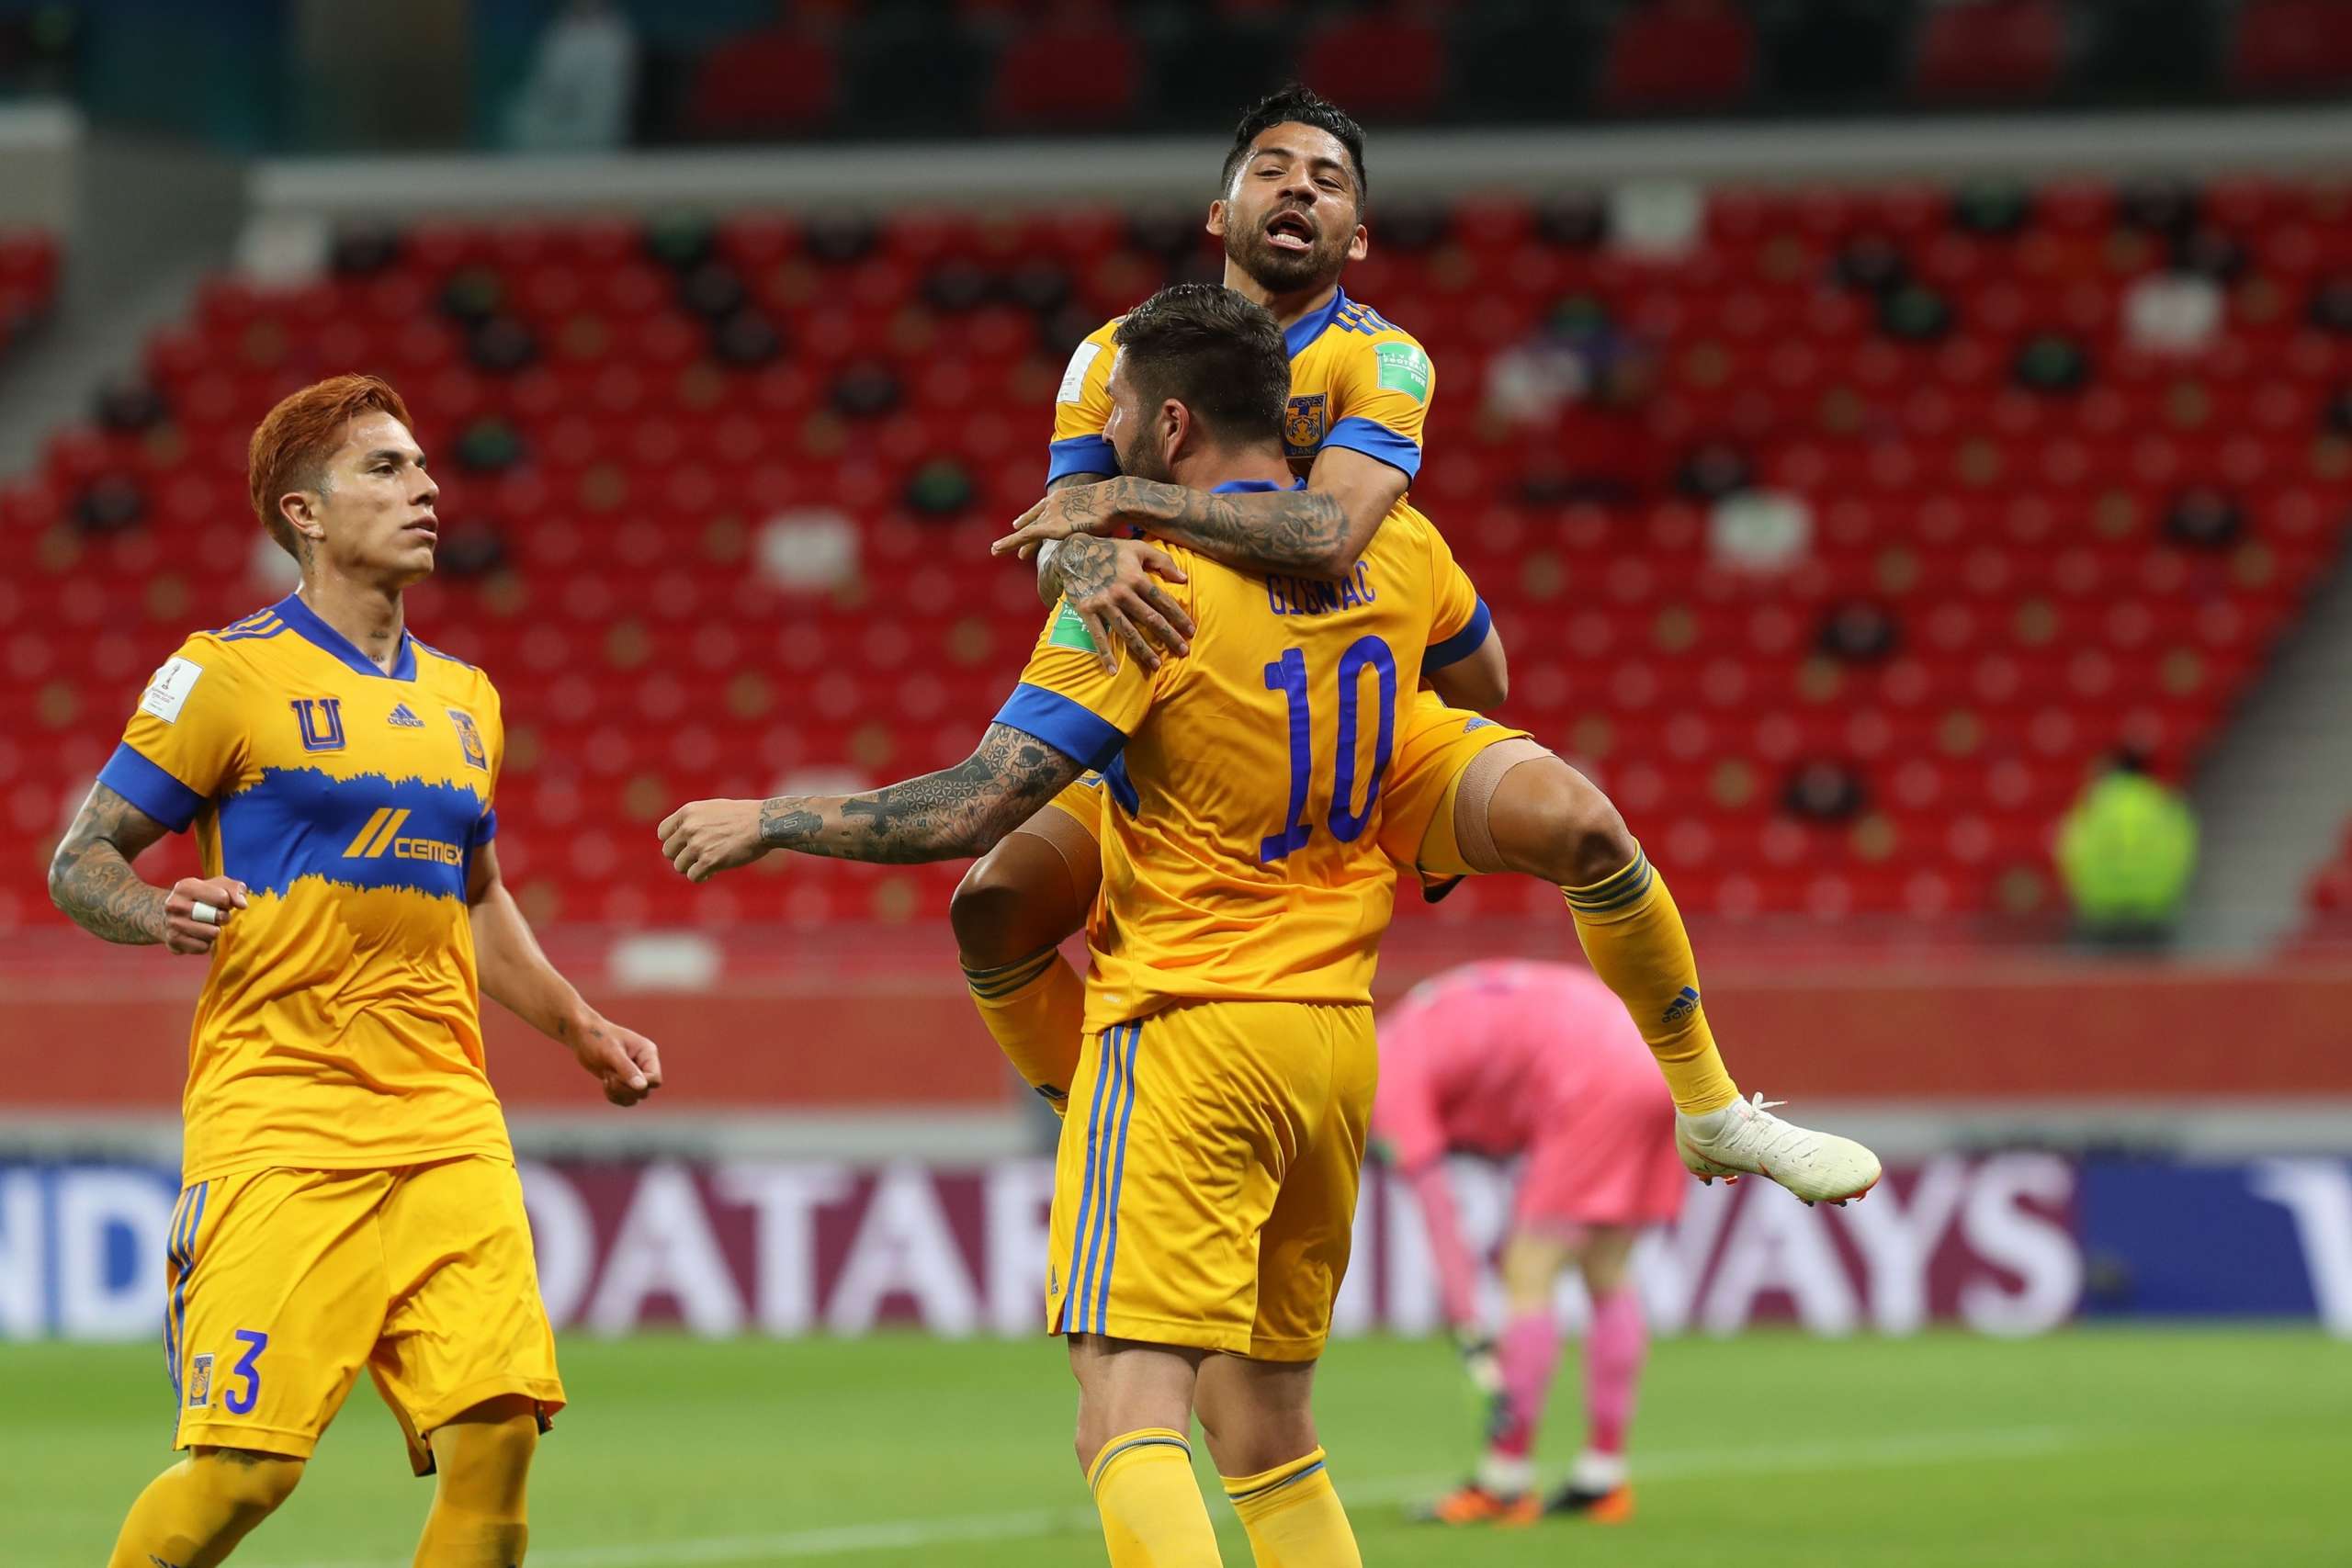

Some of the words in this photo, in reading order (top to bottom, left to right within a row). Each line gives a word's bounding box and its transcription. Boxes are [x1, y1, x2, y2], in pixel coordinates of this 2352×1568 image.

[1069, 521, 1095, 533] LIVE
[1266, 560, 1375, 615] GIGNAC
[289, 698, 346, 753] U
[387, 716, 426, 728] adidas
[1260, 635, 1396, 863] 10
[782, 816, 798, 829] 10
[393, 837, 463, 867] CEMEX
[224, 1329, 268, 1415] 3
